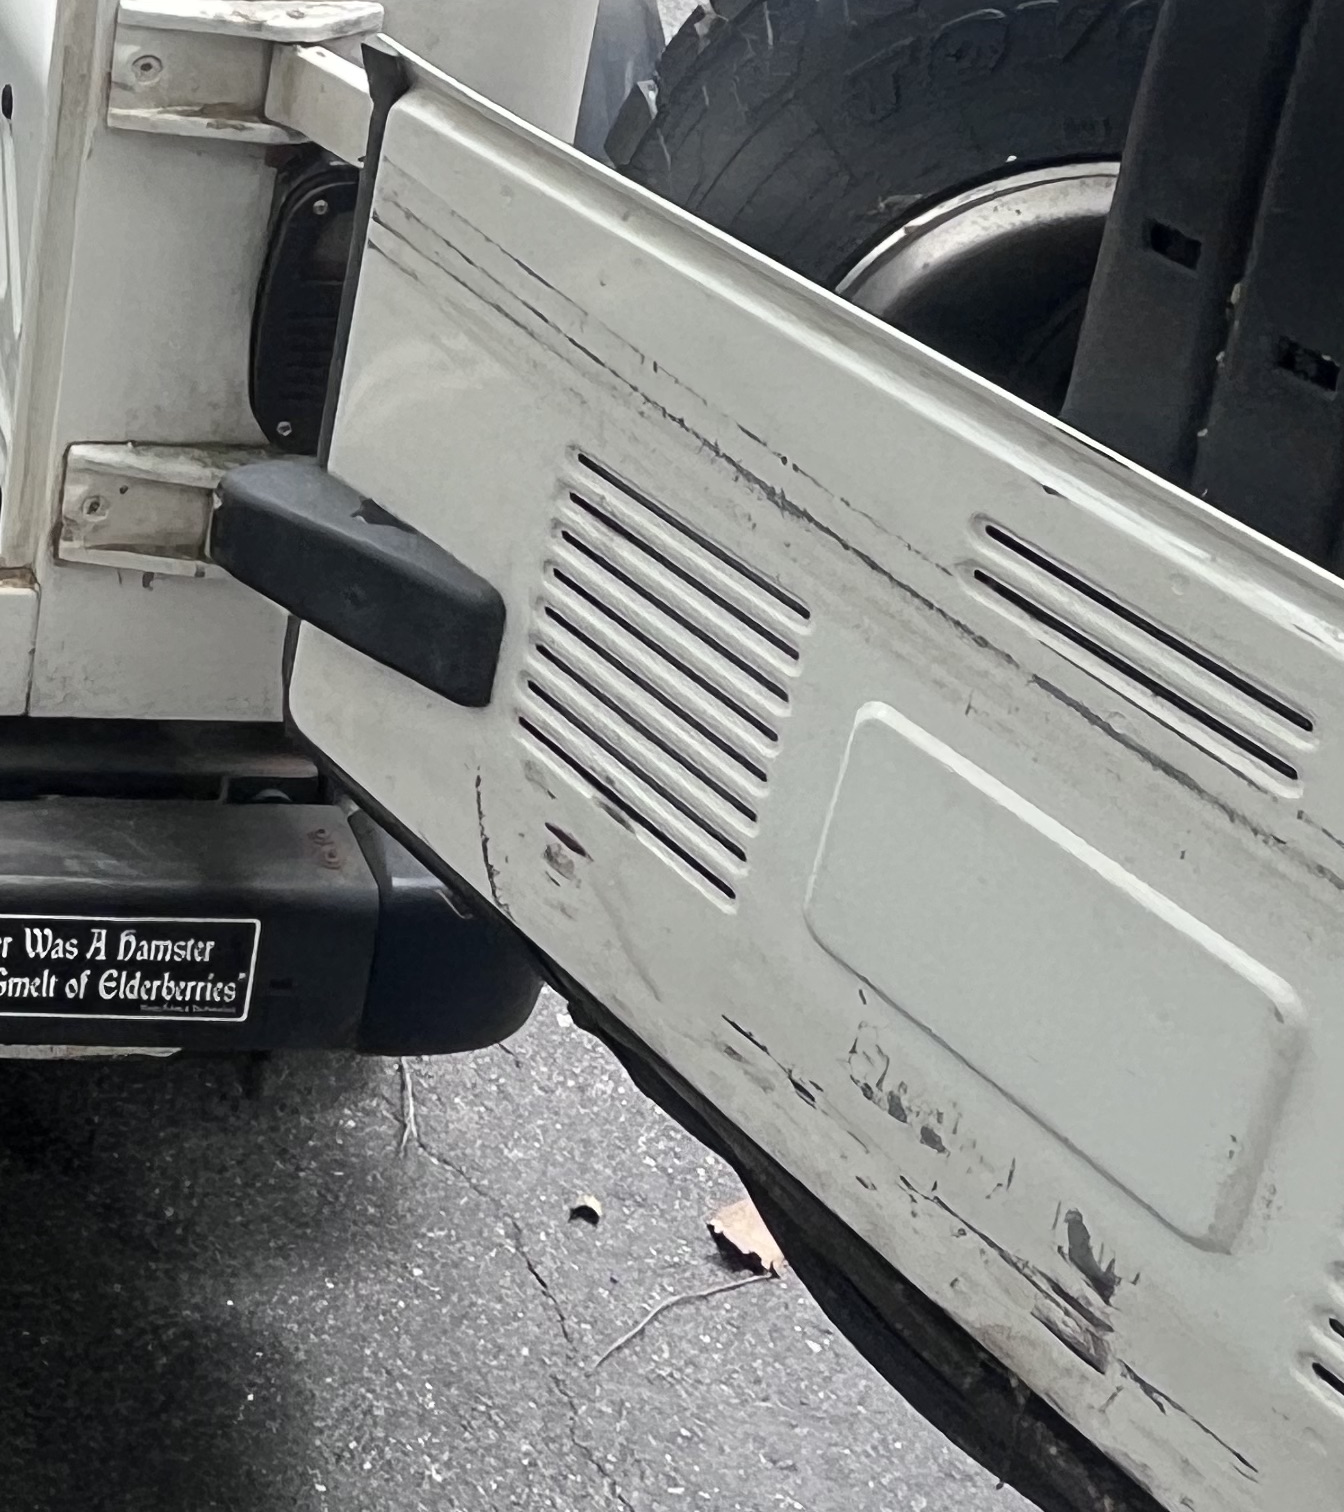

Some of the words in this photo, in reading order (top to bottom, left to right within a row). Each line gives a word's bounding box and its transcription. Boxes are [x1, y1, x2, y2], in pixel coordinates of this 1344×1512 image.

[25, 927, 79, 959] Was
[86, 929, 107, 960] A
[65, 970, 91, 999] of
